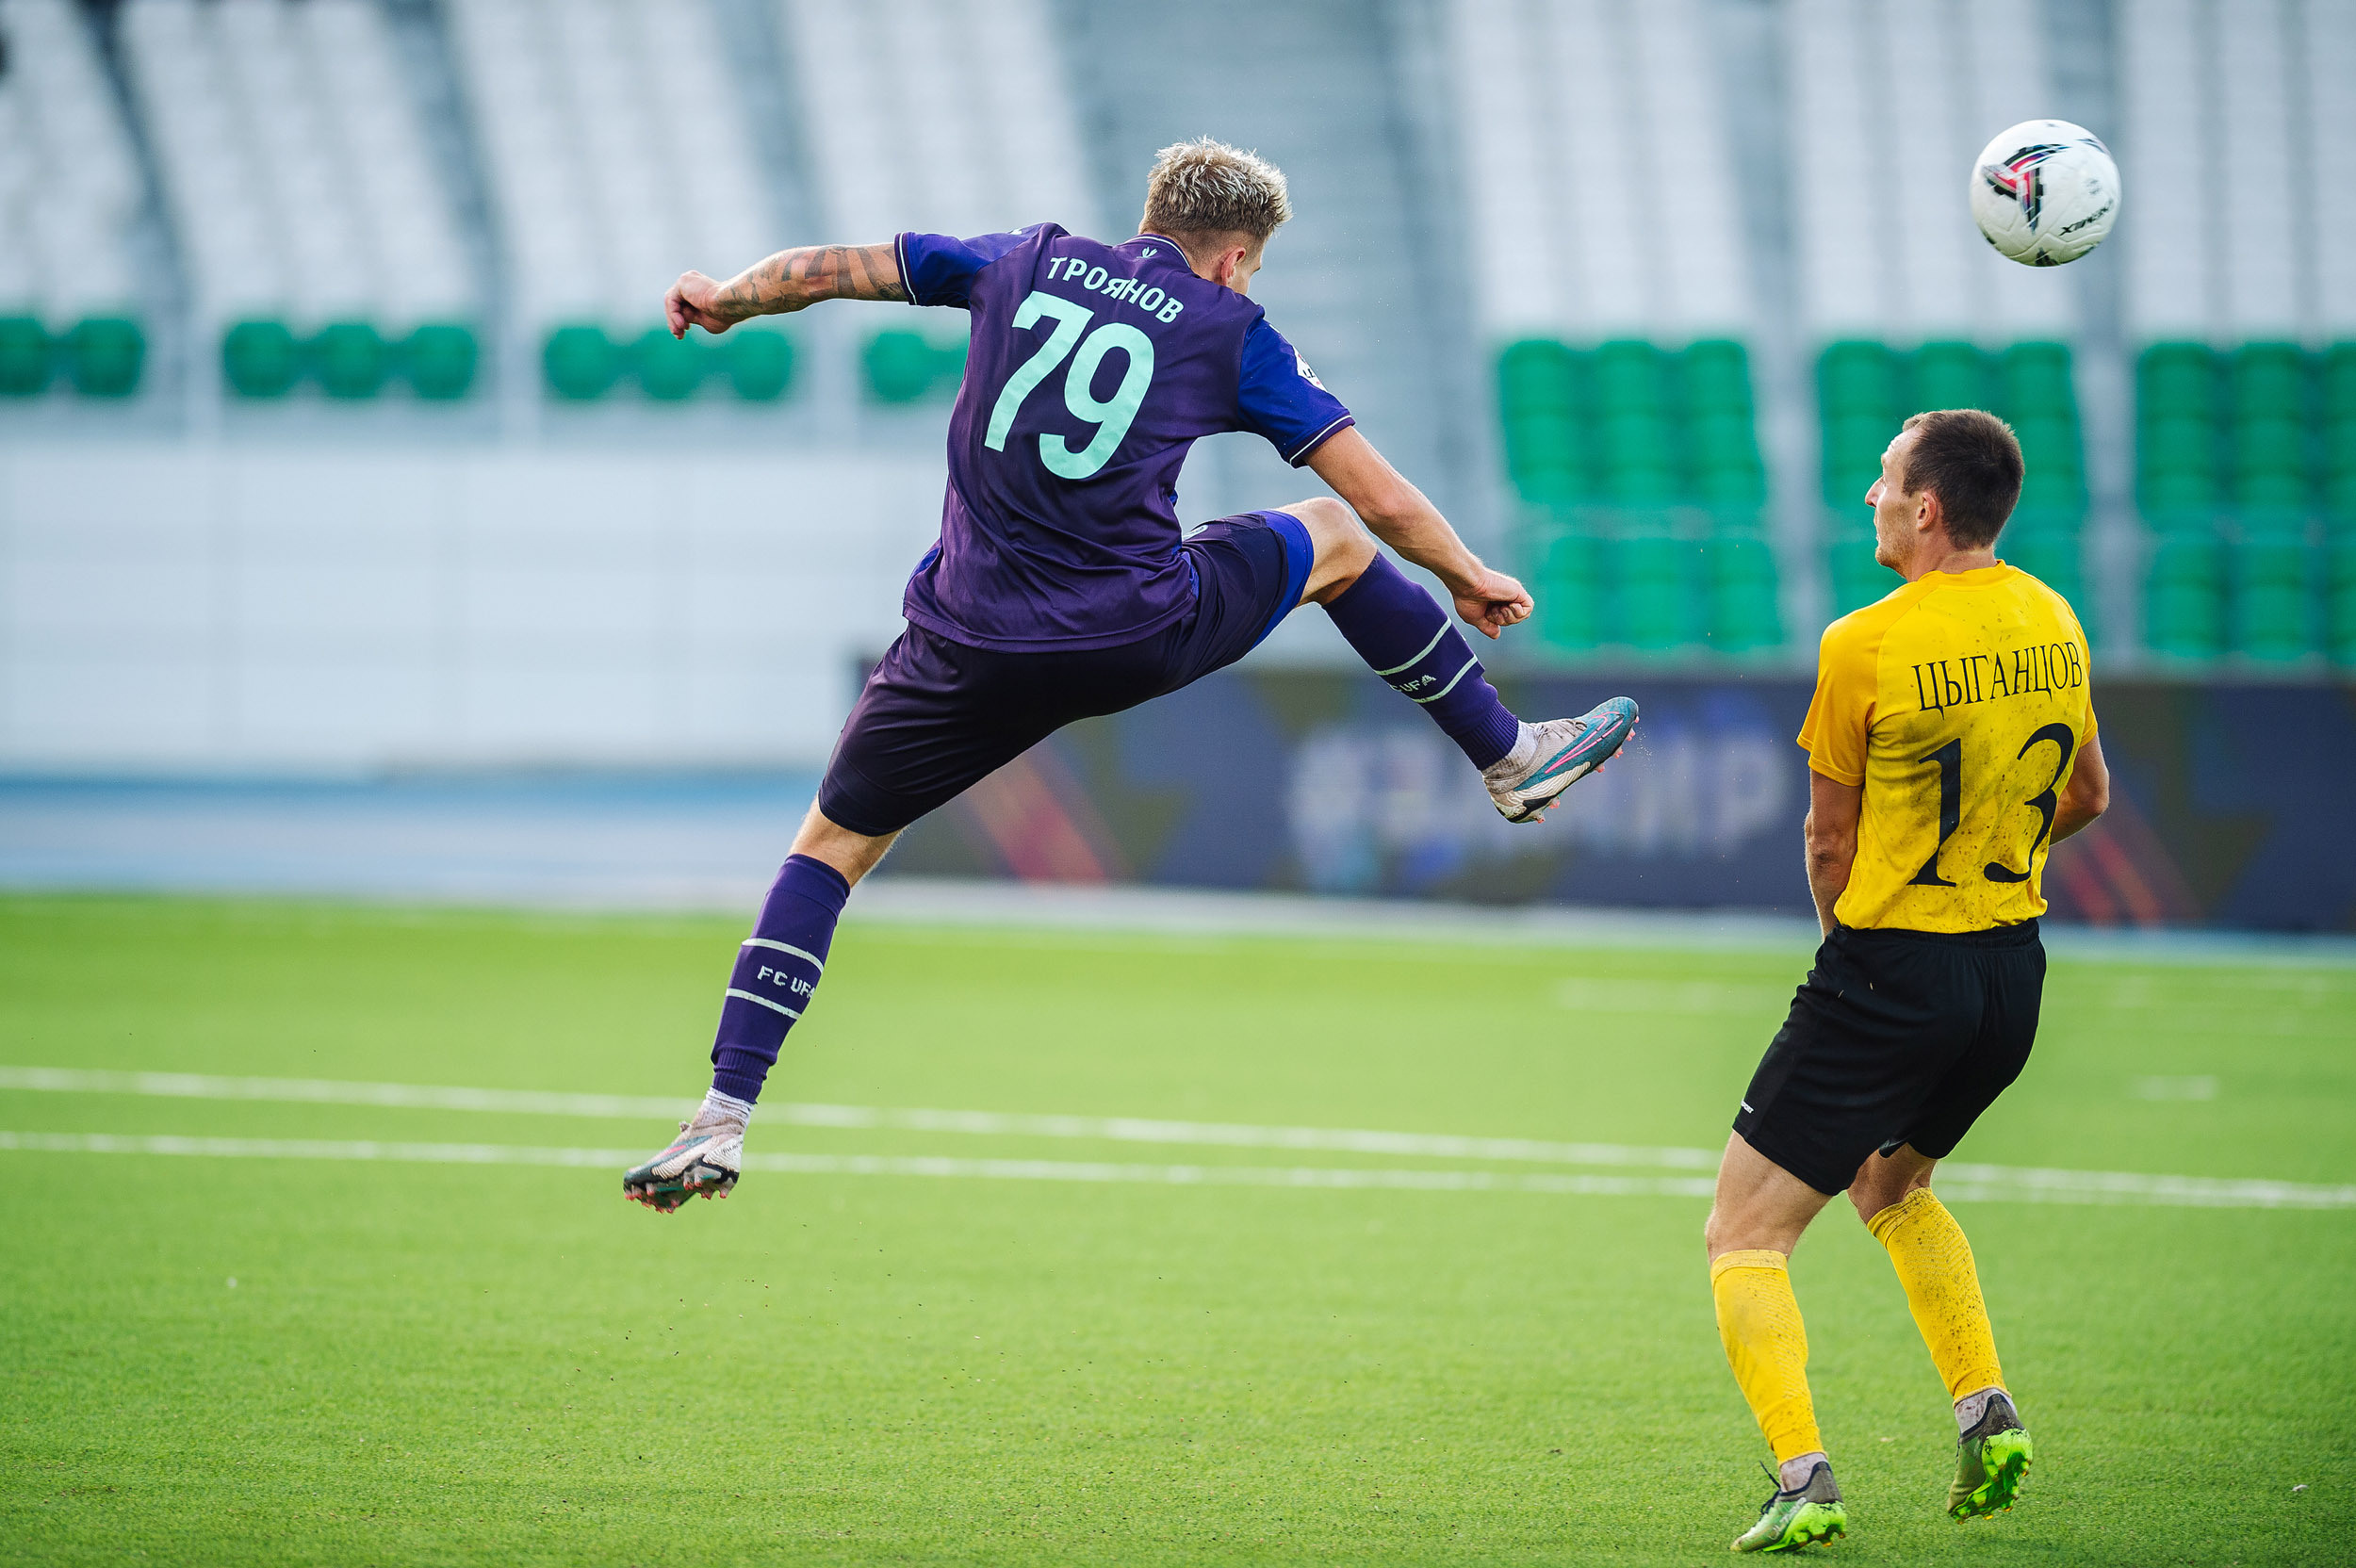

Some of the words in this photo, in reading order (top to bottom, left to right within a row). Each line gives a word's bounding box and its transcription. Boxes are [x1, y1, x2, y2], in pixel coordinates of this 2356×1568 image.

[1046, 256, 1185, 324] ТРОЯНОВ
[984, 290, 1154, 480] 79
[1399, 674, 1436, 692] UFA
[1911, 641, 2083, 720] ЦЫГАНЦОВ
[1906, 722, 2074, 888] 13
[757, 965, 788, 987] FC
